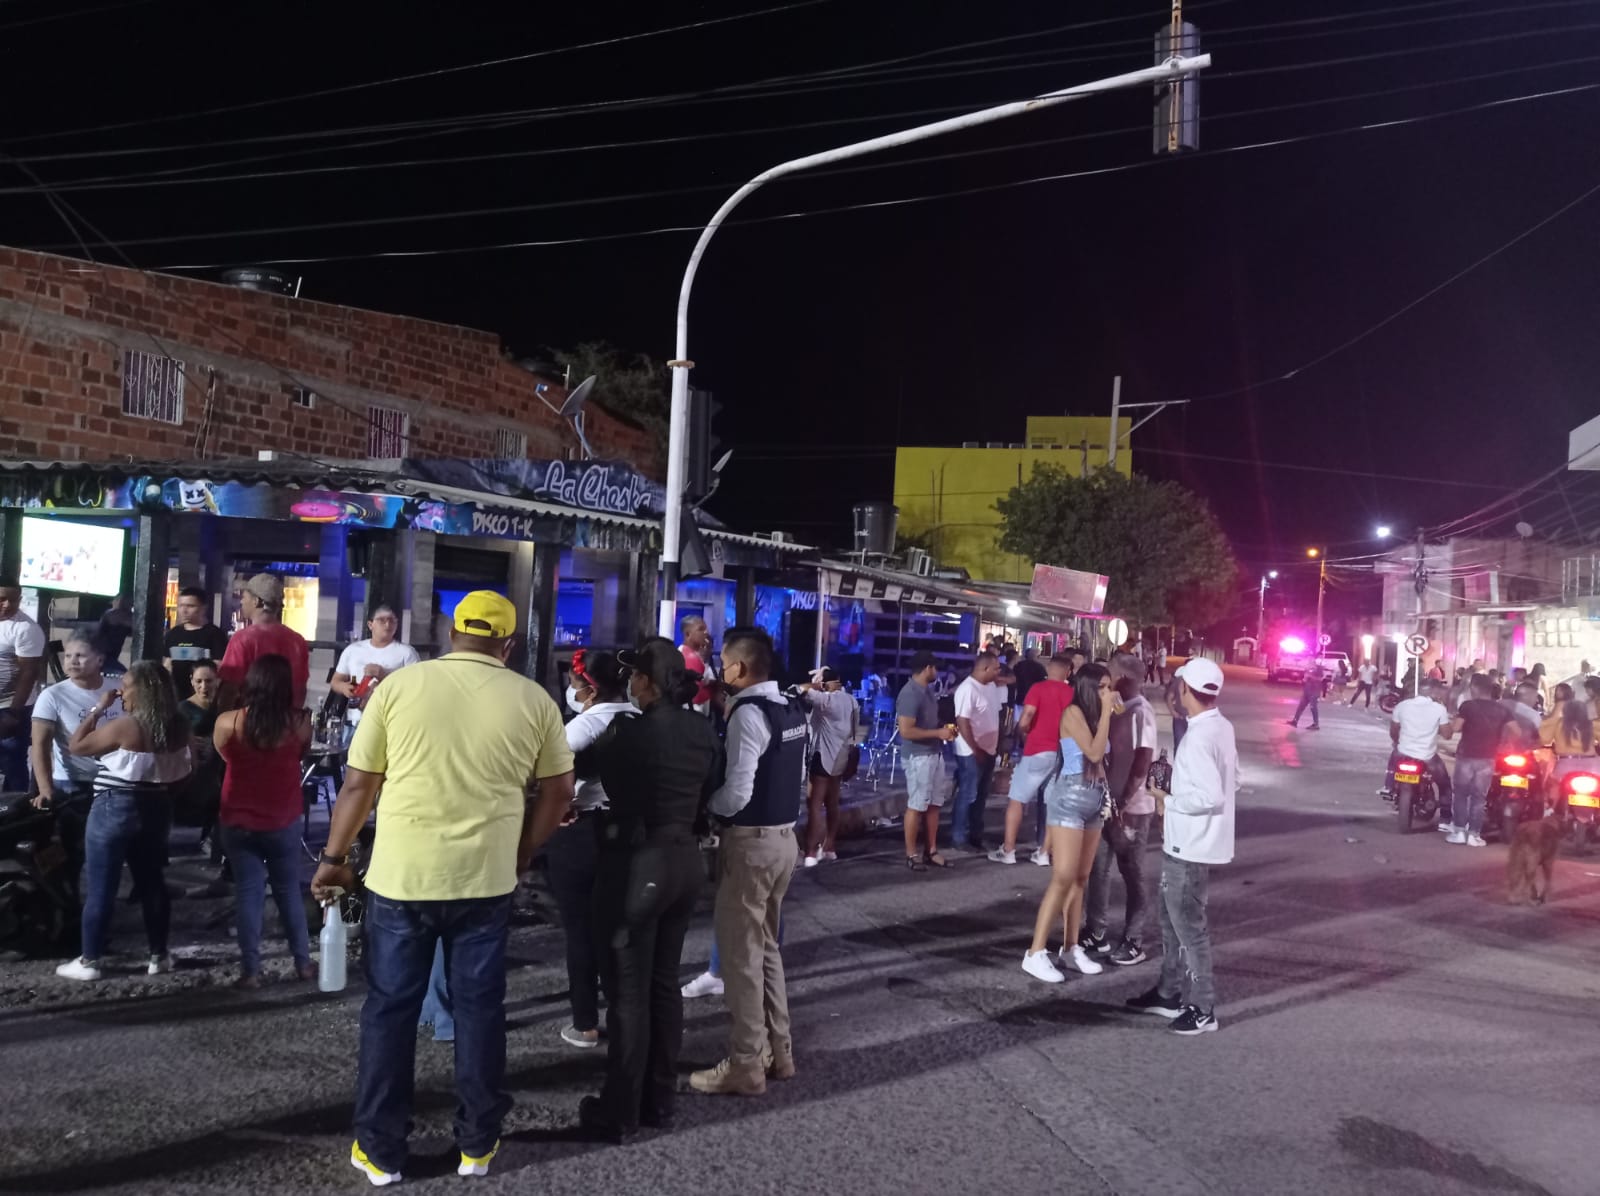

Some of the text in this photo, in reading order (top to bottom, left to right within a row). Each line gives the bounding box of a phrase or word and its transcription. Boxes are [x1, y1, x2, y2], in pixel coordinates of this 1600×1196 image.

[535, 460, 577, 506] La
[472, 511, 533, 538] DISCO T-K
[790, 591, 817, 610] DISCO
[1412, 637, 1425, 652] P
